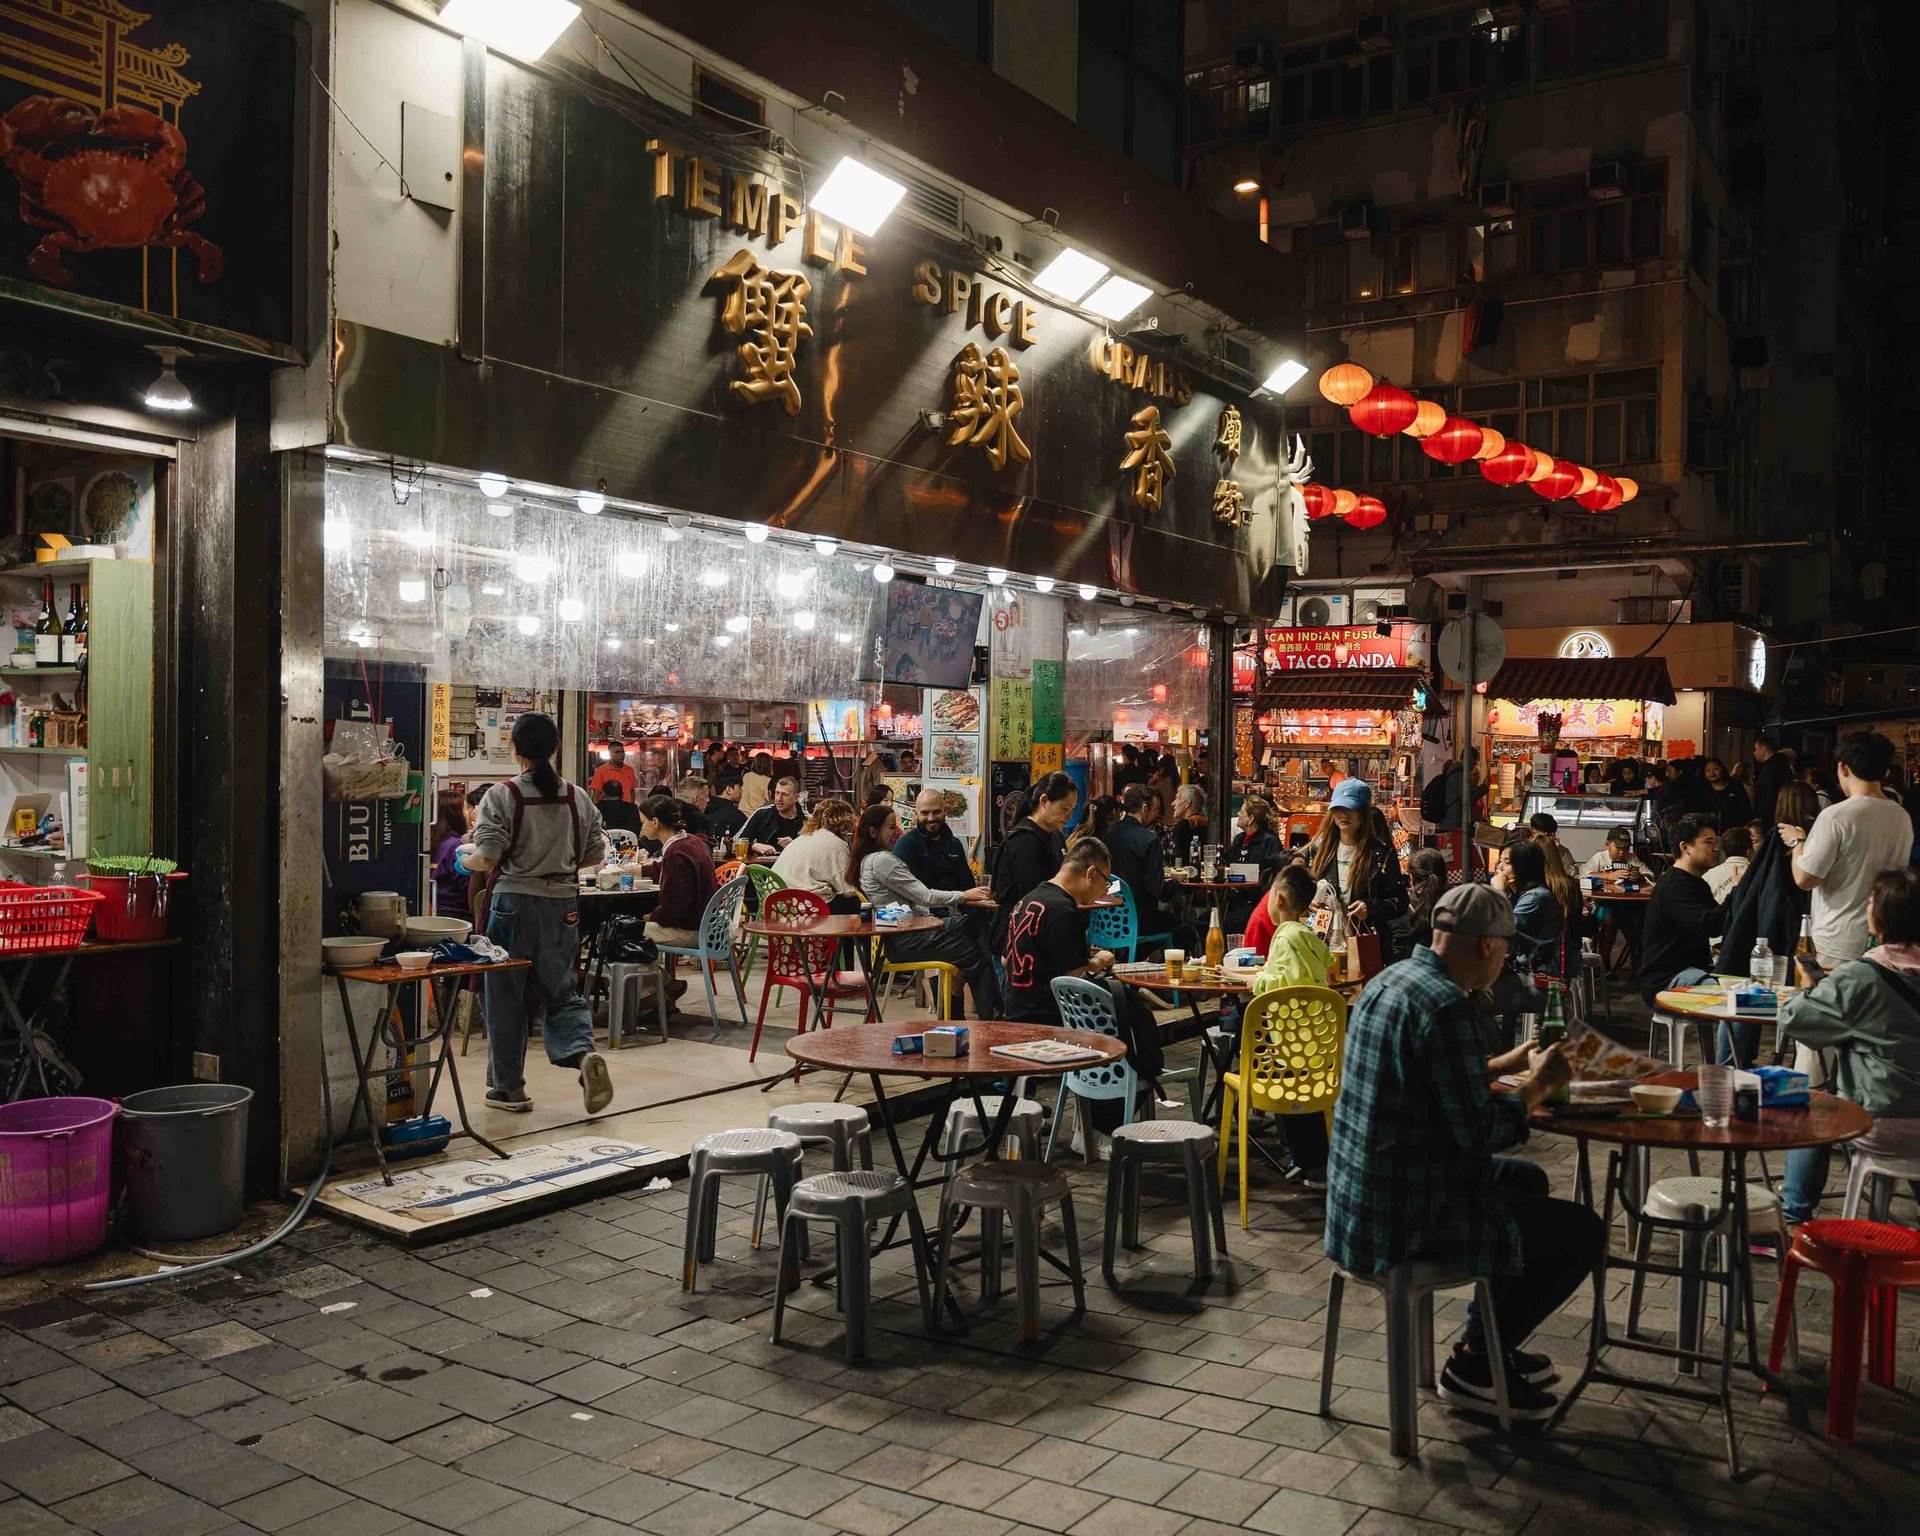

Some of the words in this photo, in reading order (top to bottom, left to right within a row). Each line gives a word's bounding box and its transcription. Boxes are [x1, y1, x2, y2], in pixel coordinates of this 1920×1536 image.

[645, 139, 867, 276] TEMPLE
[913, 259, 1038, 349] SPICE
[1092, 336, 1192, 407] CRABS
[712, 248, 814, 416] 蟹
[947, 343, 1031, 471] 辣
[1119, 405, 1176, 513] 香
[1344, 629, 1389, 641] FUSIO
[1286, 654, 1331, 669] TACO
[1281, 716, 1373, 737] 美食皇后
